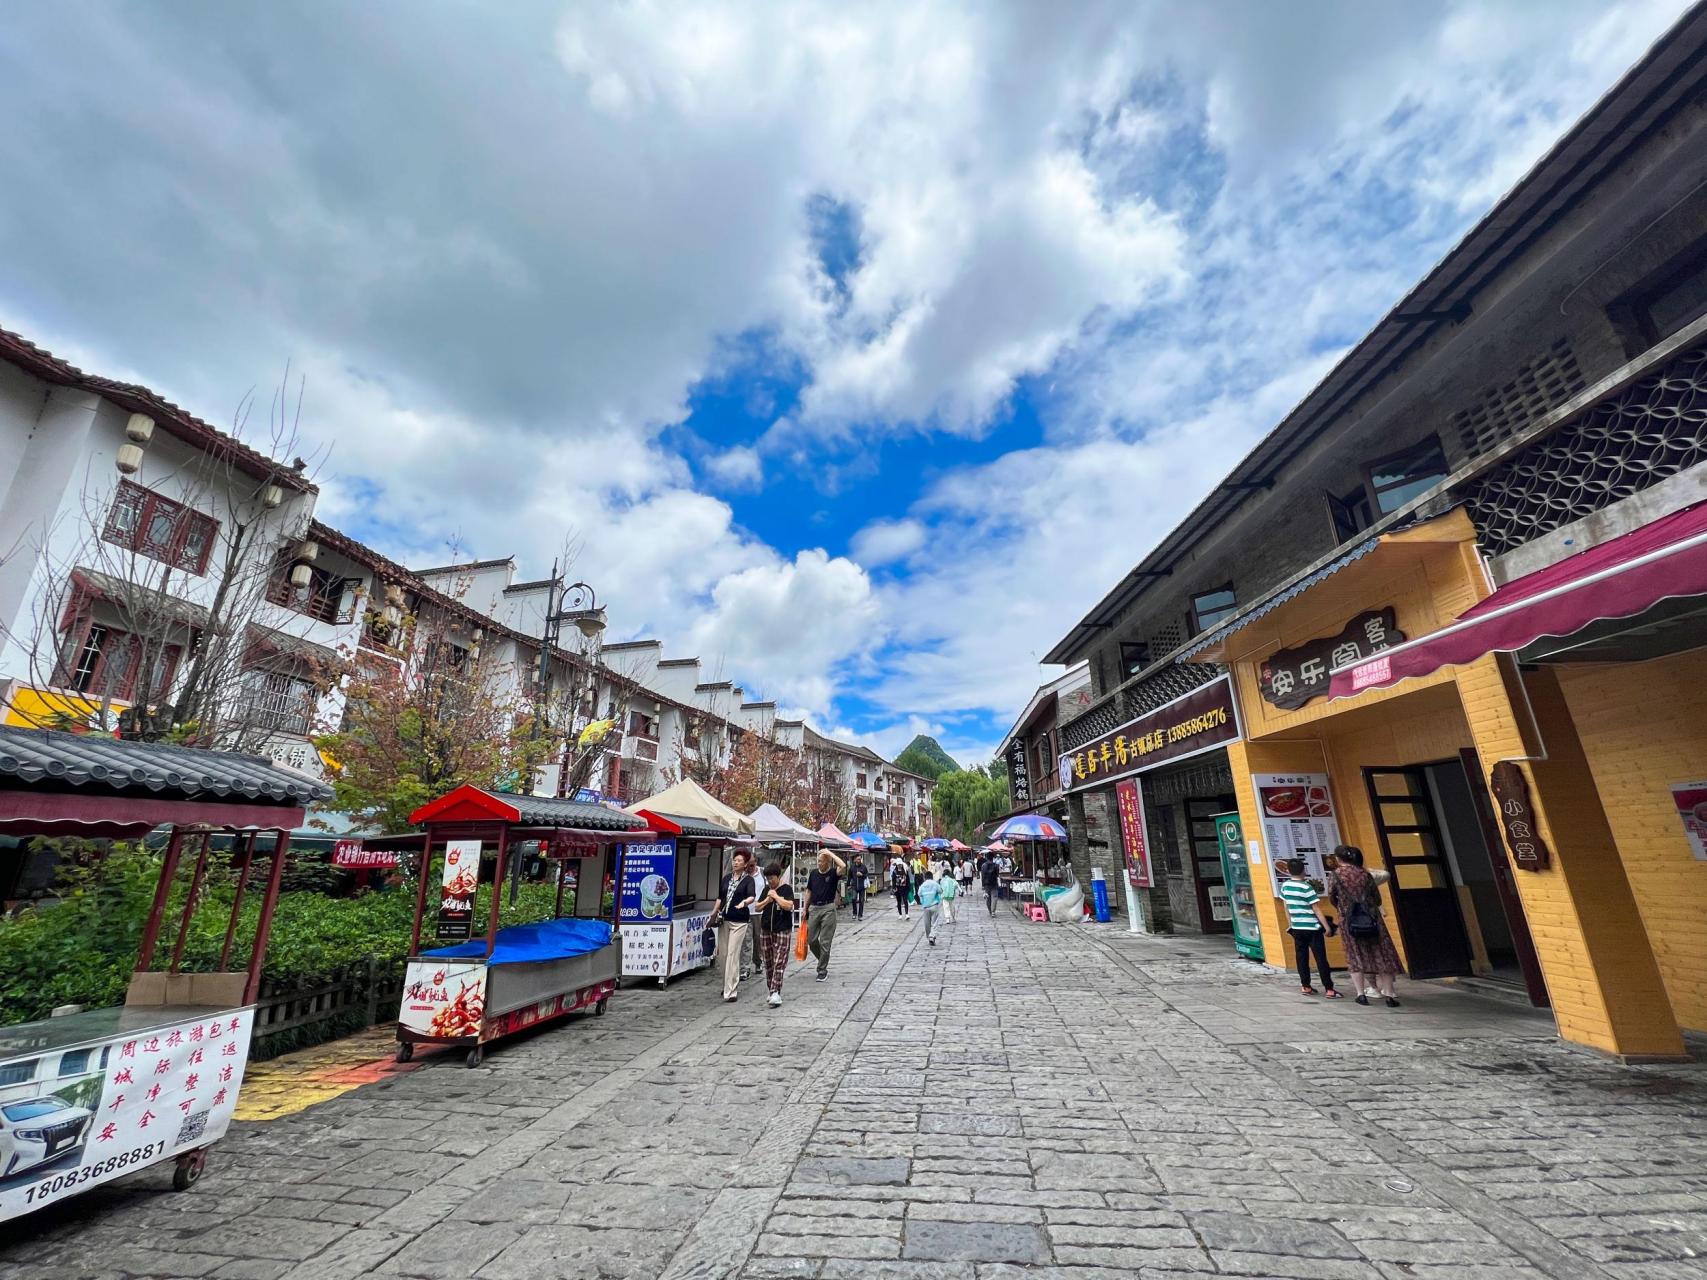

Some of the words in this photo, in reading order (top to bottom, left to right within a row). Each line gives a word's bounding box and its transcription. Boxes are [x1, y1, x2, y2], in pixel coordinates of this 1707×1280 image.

[1167, 706, 1227, 744] 13885864276
[1504, 798, 1538, 861] 小食堂
[120, 1017, 240, 1060] 周边旅游包车
[114, 1041, 236, 1085] 城际往返
[108, 1064, 233, 1113] 干净整洁
[25, 1140, 165, 1204] 18083688881
